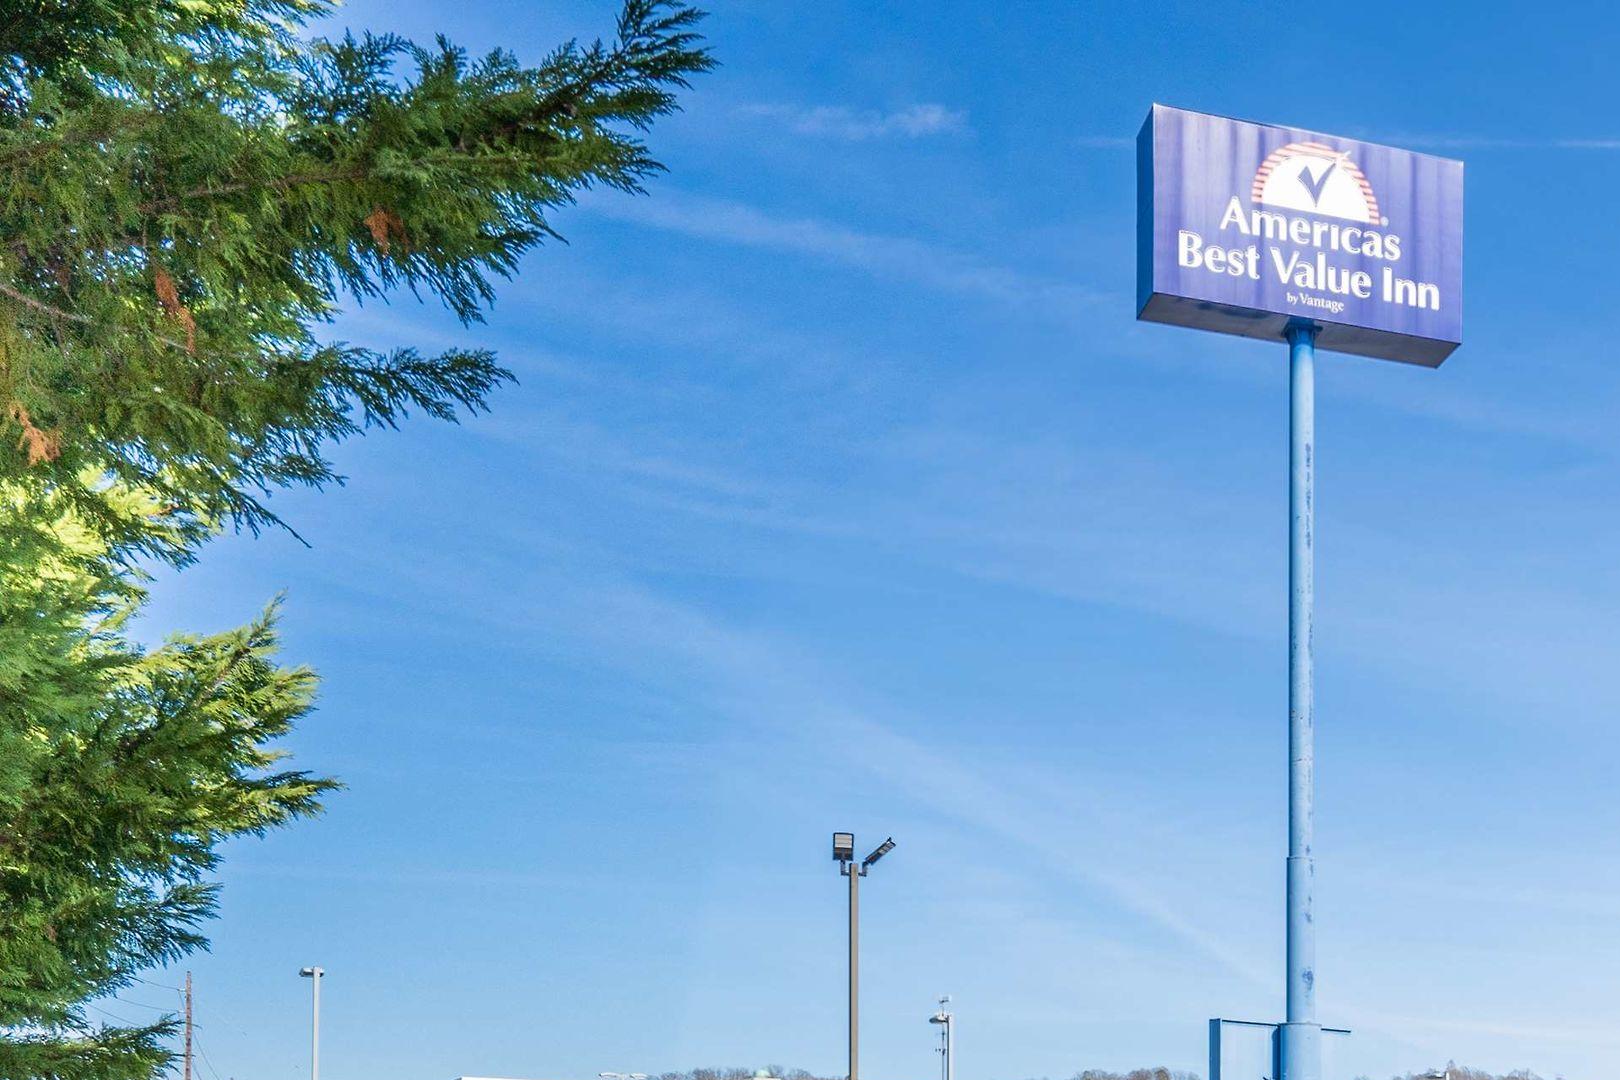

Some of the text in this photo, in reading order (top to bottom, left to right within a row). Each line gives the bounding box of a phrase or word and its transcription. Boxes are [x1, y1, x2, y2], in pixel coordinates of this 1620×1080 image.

[1220, 195, 1401, 261] Americas
[1178, 229, 1440, 311] Best Value Inn
[1286, 292, 1345, 313] by Vantage
